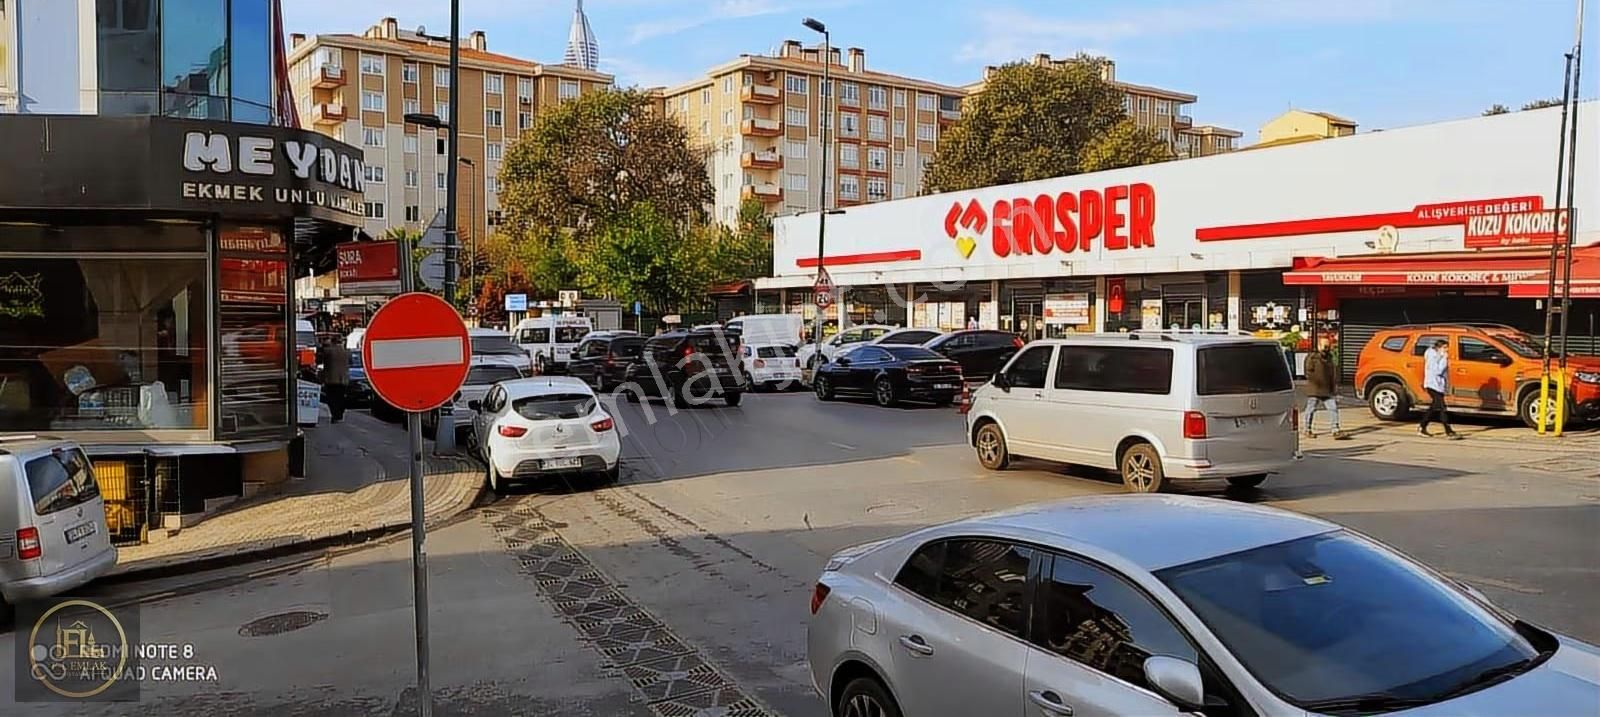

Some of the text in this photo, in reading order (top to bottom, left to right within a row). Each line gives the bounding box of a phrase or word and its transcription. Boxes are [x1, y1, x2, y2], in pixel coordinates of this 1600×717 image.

[183, 131, 365, 192] MEYDAN
[183, 182, 264, 201] EKMEK
[275, 188, 325, 206] UNLU
[992, 182, 1156, 258] GROSPER
[1468, 215, 1502, 236] KUZU
